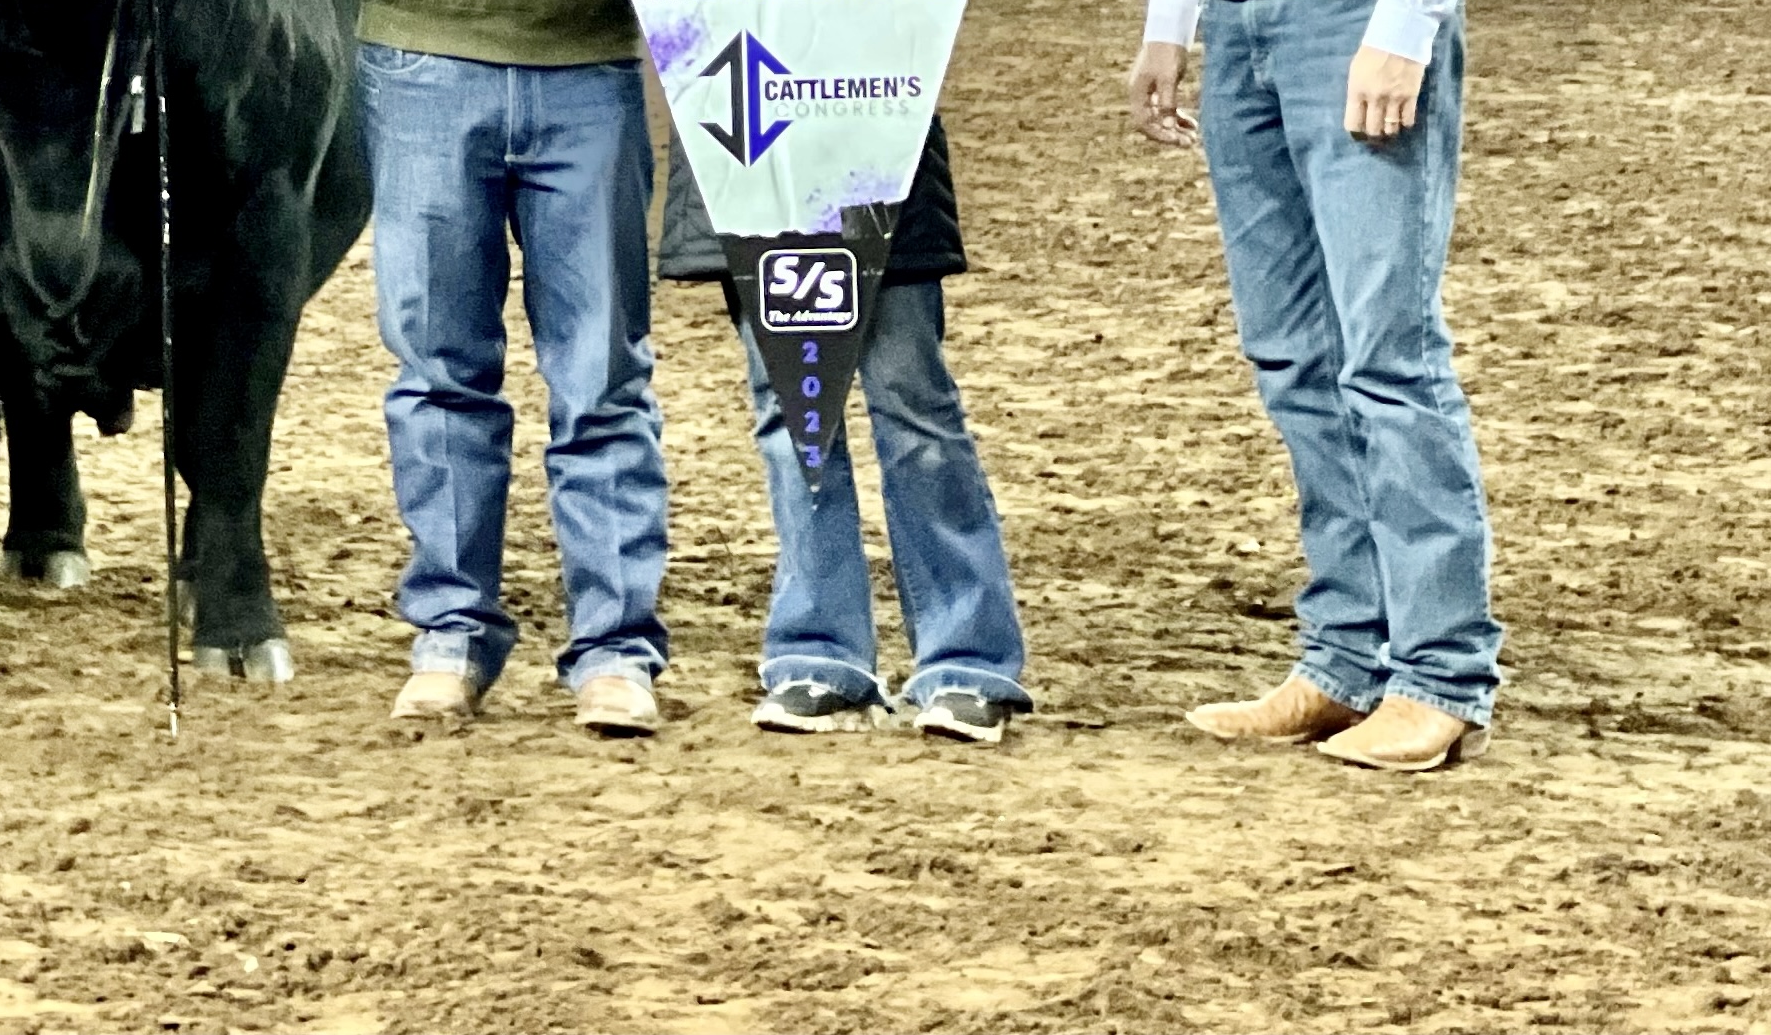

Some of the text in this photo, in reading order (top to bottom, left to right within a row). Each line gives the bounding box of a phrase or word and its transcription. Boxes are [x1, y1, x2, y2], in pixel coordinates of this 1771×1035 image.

[764, 75, 922, 101] CATTLEMEN'S
[773, 99, 911, 119] CONGRESS
[770, 255, 845, 309] S/S
